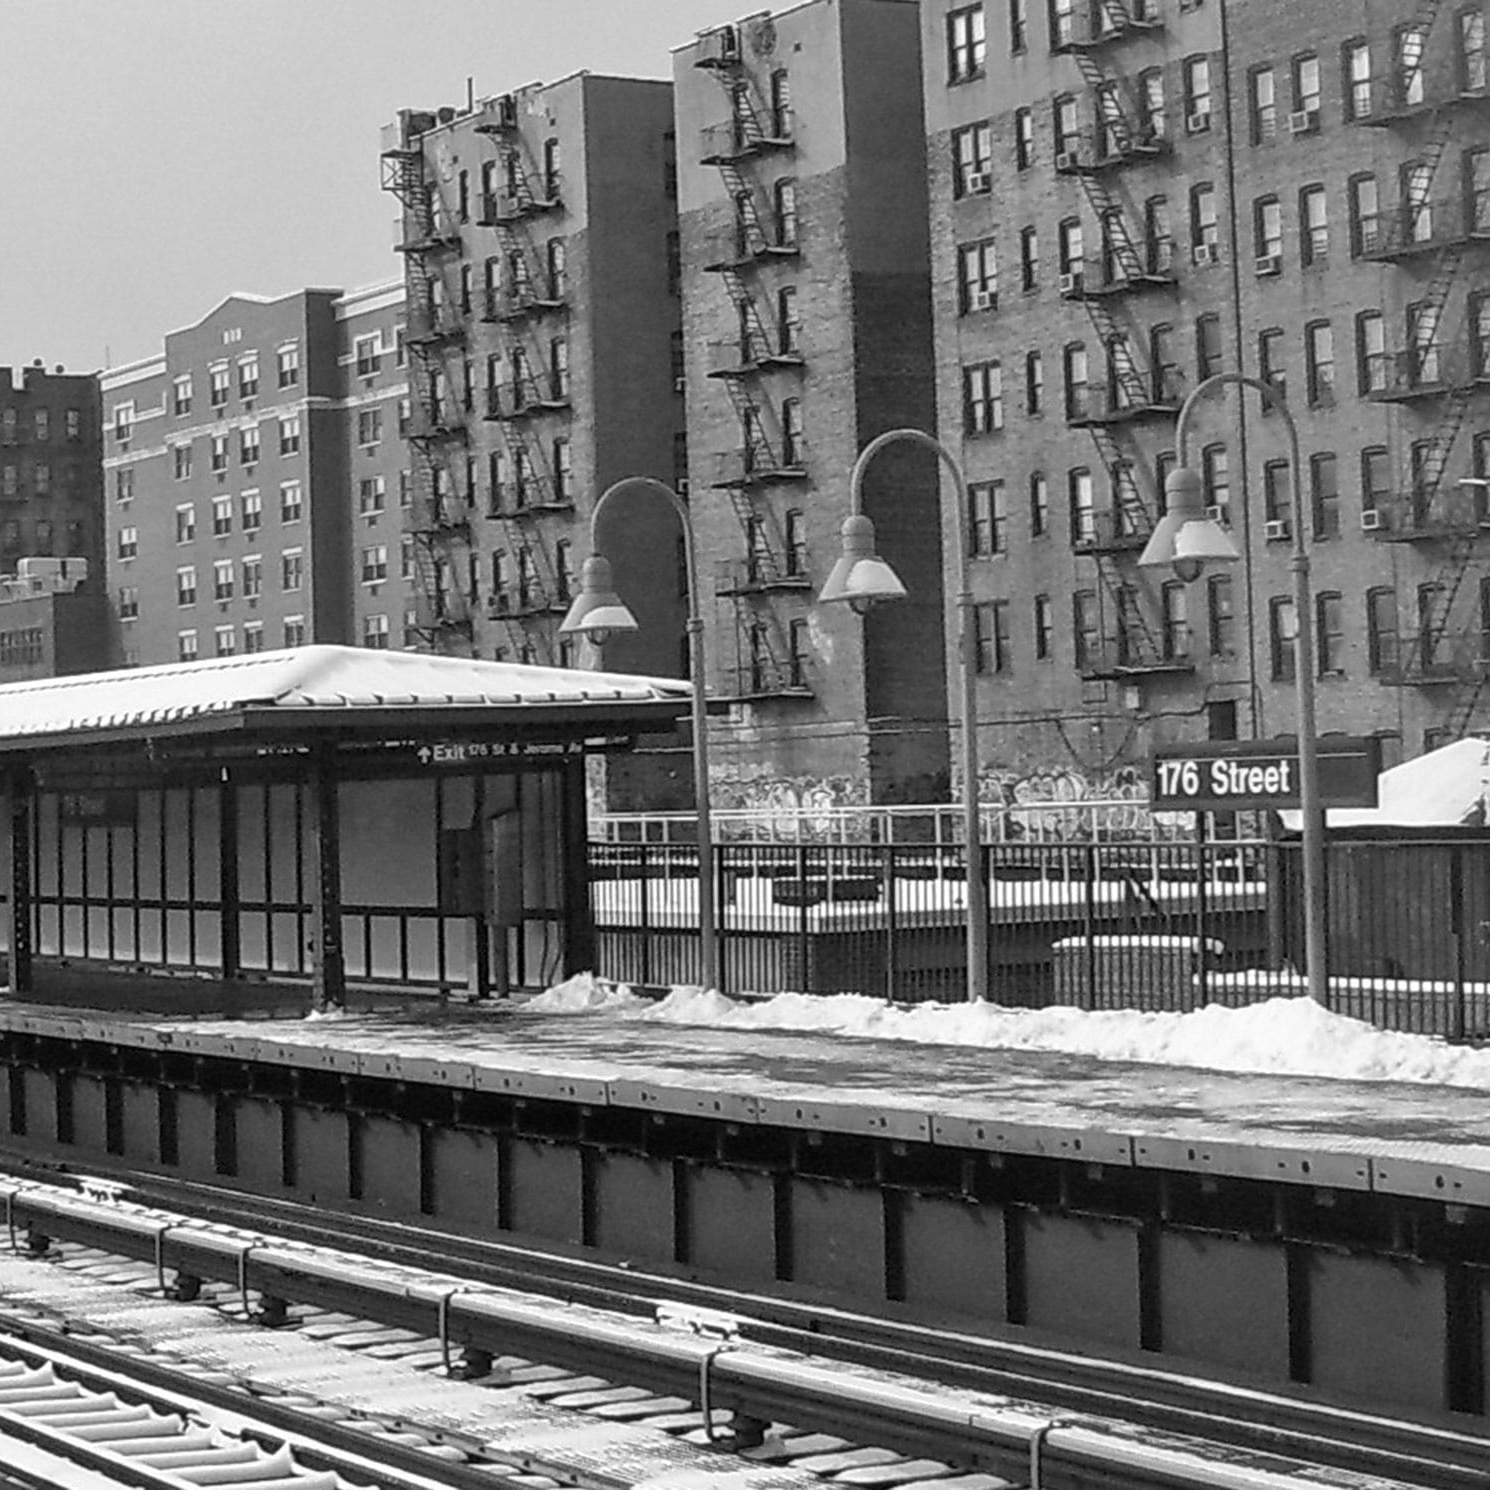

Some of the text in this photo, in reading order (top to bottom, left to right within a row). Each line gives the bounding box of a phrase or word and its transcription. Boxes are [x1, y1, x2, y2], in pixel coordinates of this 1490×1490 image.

[433, 743, 465, 761] Exit
[468, 743, 488, 756] 176
[492, 743, 505, 755] St
[1157, 760, 1291, 795] 176 Street
